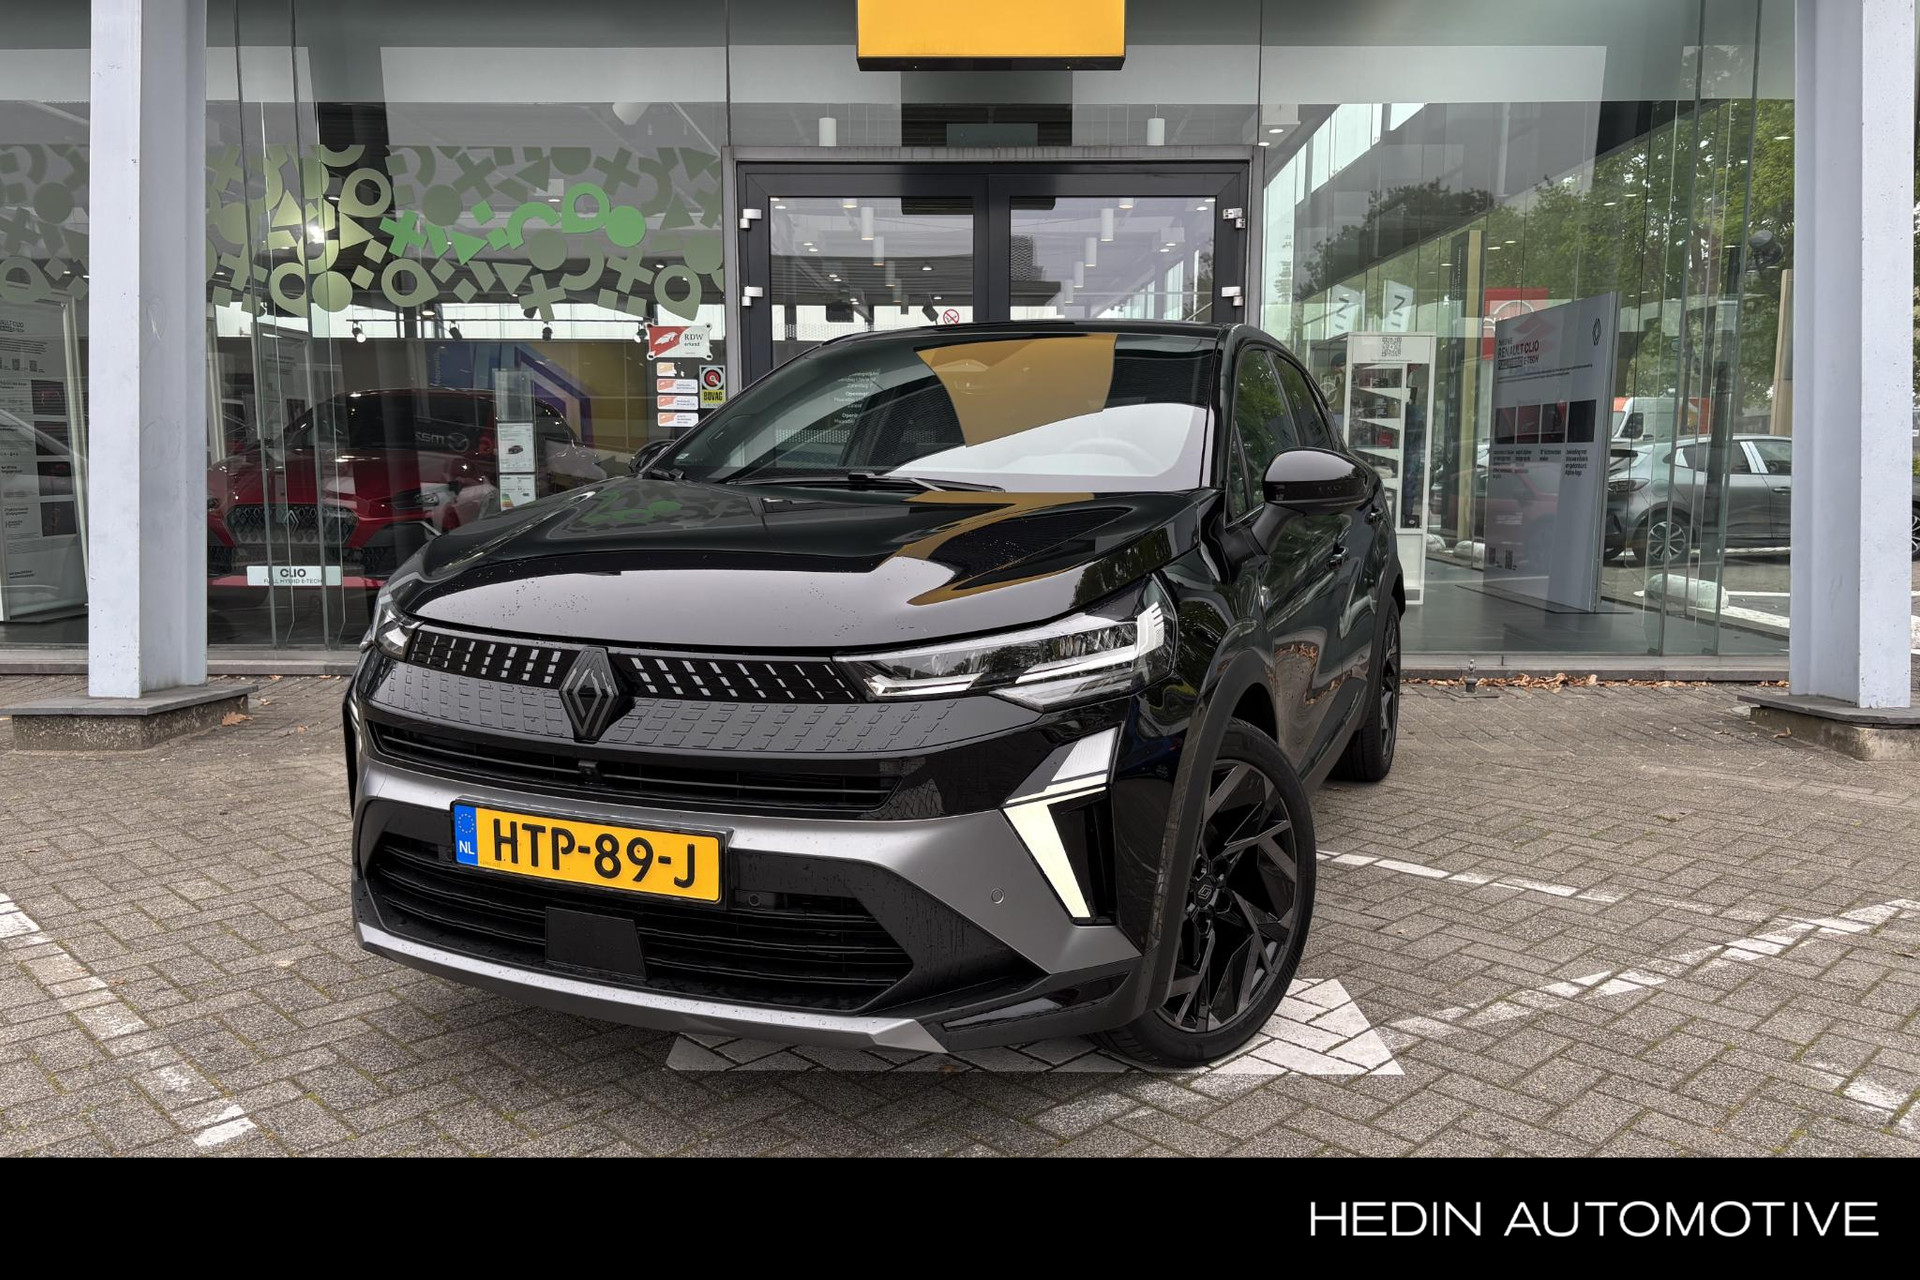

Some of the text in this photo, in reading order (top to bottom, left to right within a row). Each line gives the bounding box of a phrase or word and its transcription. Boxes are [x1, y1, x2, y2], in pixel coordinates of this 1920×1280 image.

[684, 333, 704, 341] RDW
[1498, 340, 1540, 358] RENAULT CLIO
[703, 391, 723, 401] BOVAG
[280, 568, 307, 578] CLIO
[459, 840, 475, 855] NL
[493, 818, 696, 889] HTP-89-J
